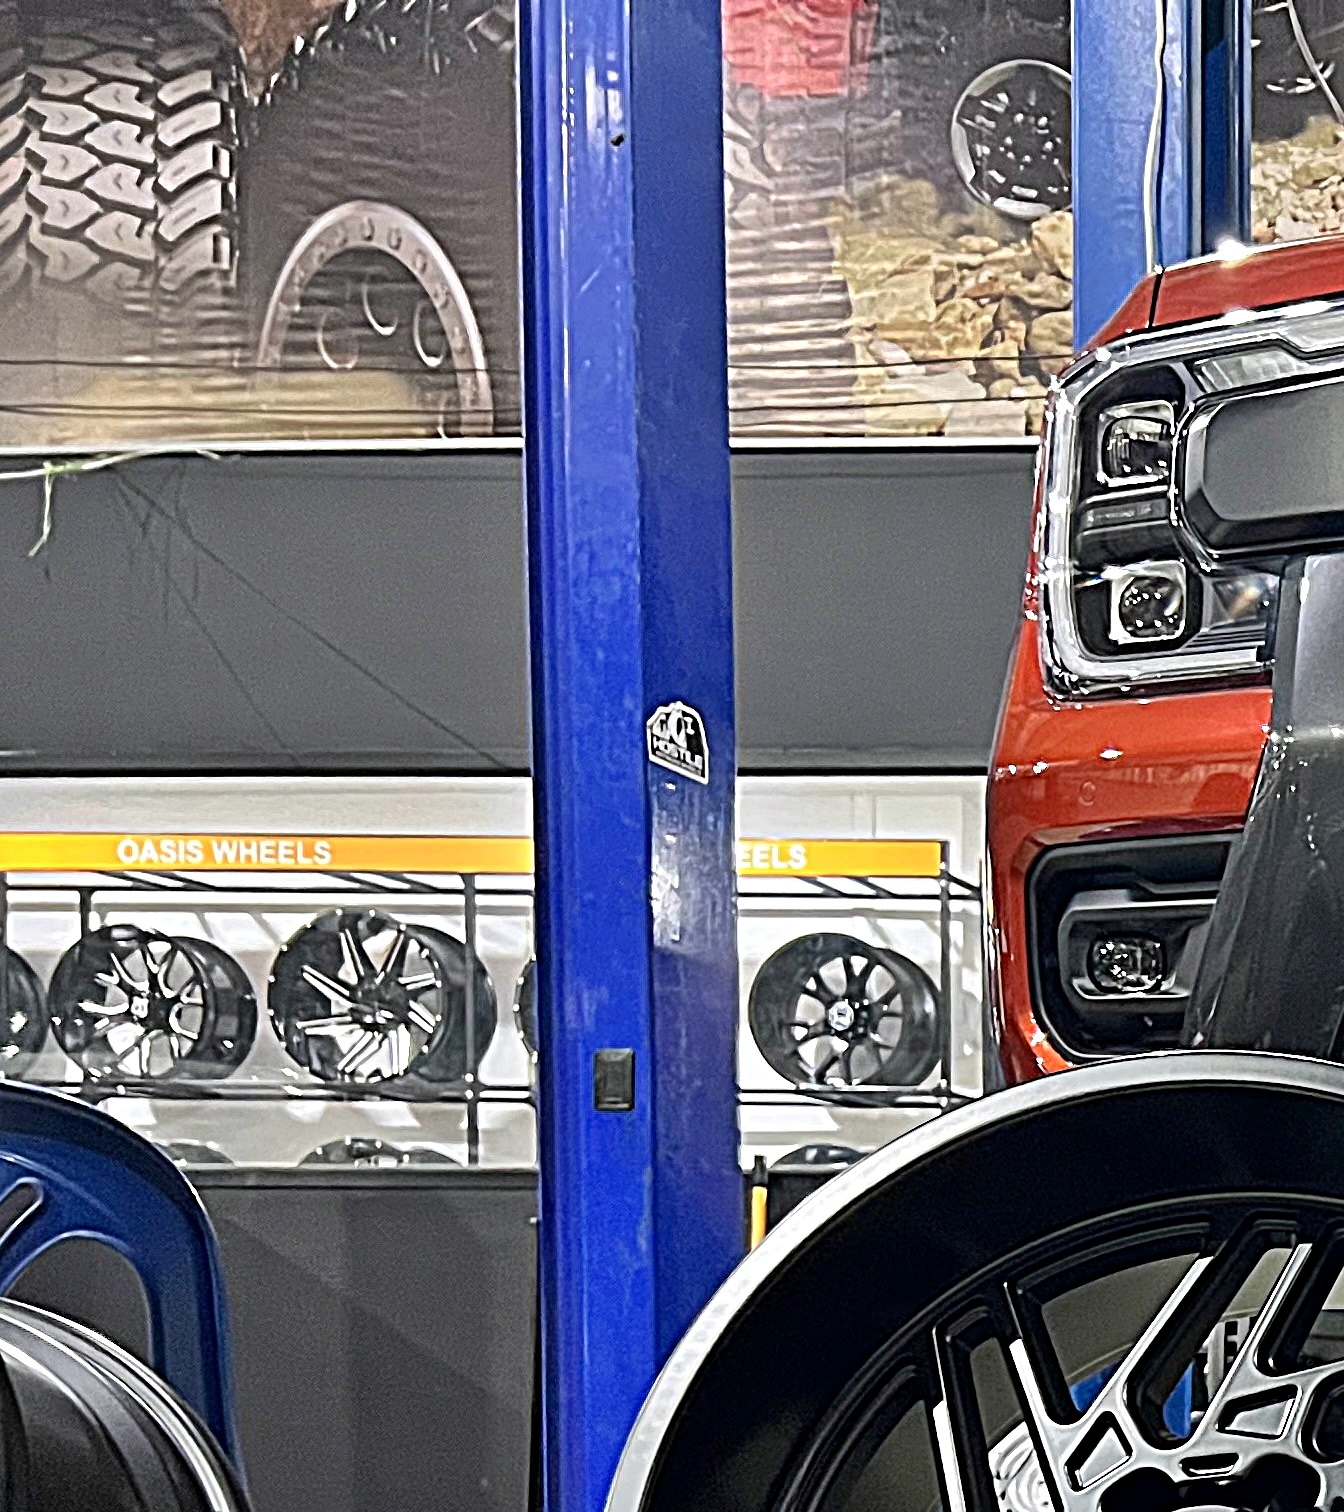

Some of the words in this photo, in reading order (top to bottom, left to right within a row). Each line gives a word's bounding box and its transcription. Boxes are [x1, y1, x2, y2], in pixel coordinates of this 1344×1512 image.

[117, 838, 204, 864] OASIS
[211, 839, 332, 865] WHEELS
[739, 843, 806, 869] EELS
